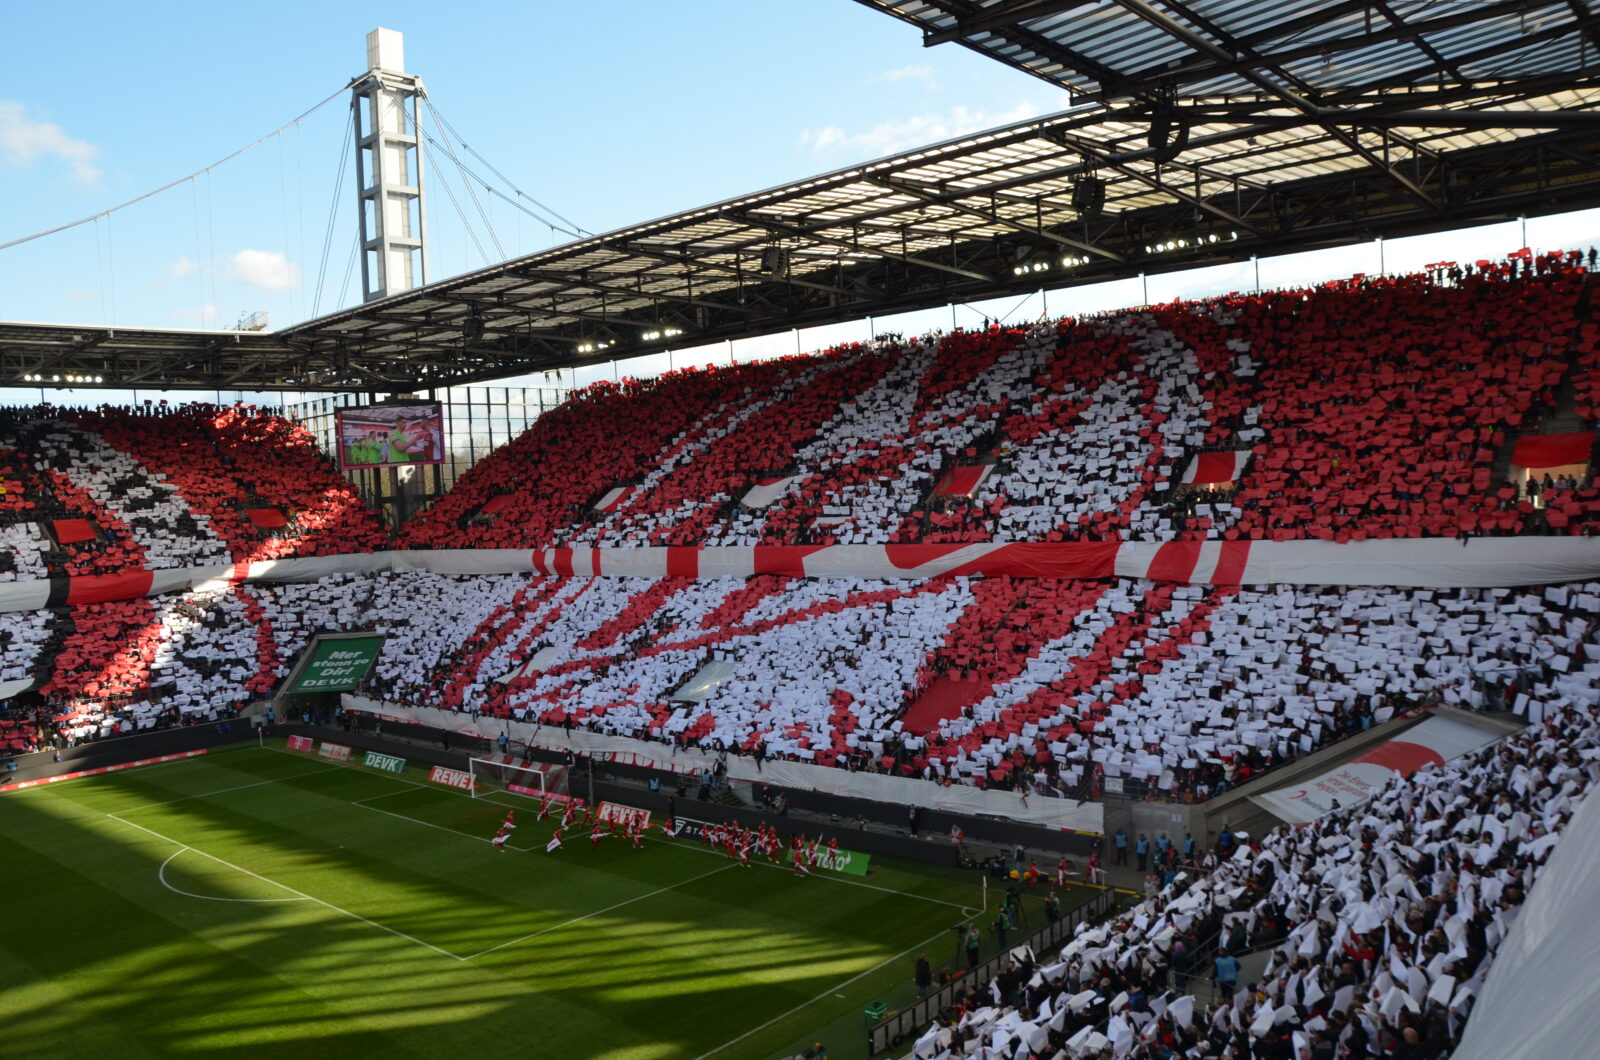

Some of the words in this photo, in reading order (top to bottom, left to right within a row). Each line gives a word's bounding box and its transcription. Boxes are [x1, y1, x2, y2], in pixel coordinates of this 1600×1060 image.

[328, 651, 363, 660] Mer
[320, 667, 355, 676] Dir!
[302, 677, 355, 687] DEVK
[365, 754, 398, 772] DEVK
[432, 766, 472, 789] REWE
